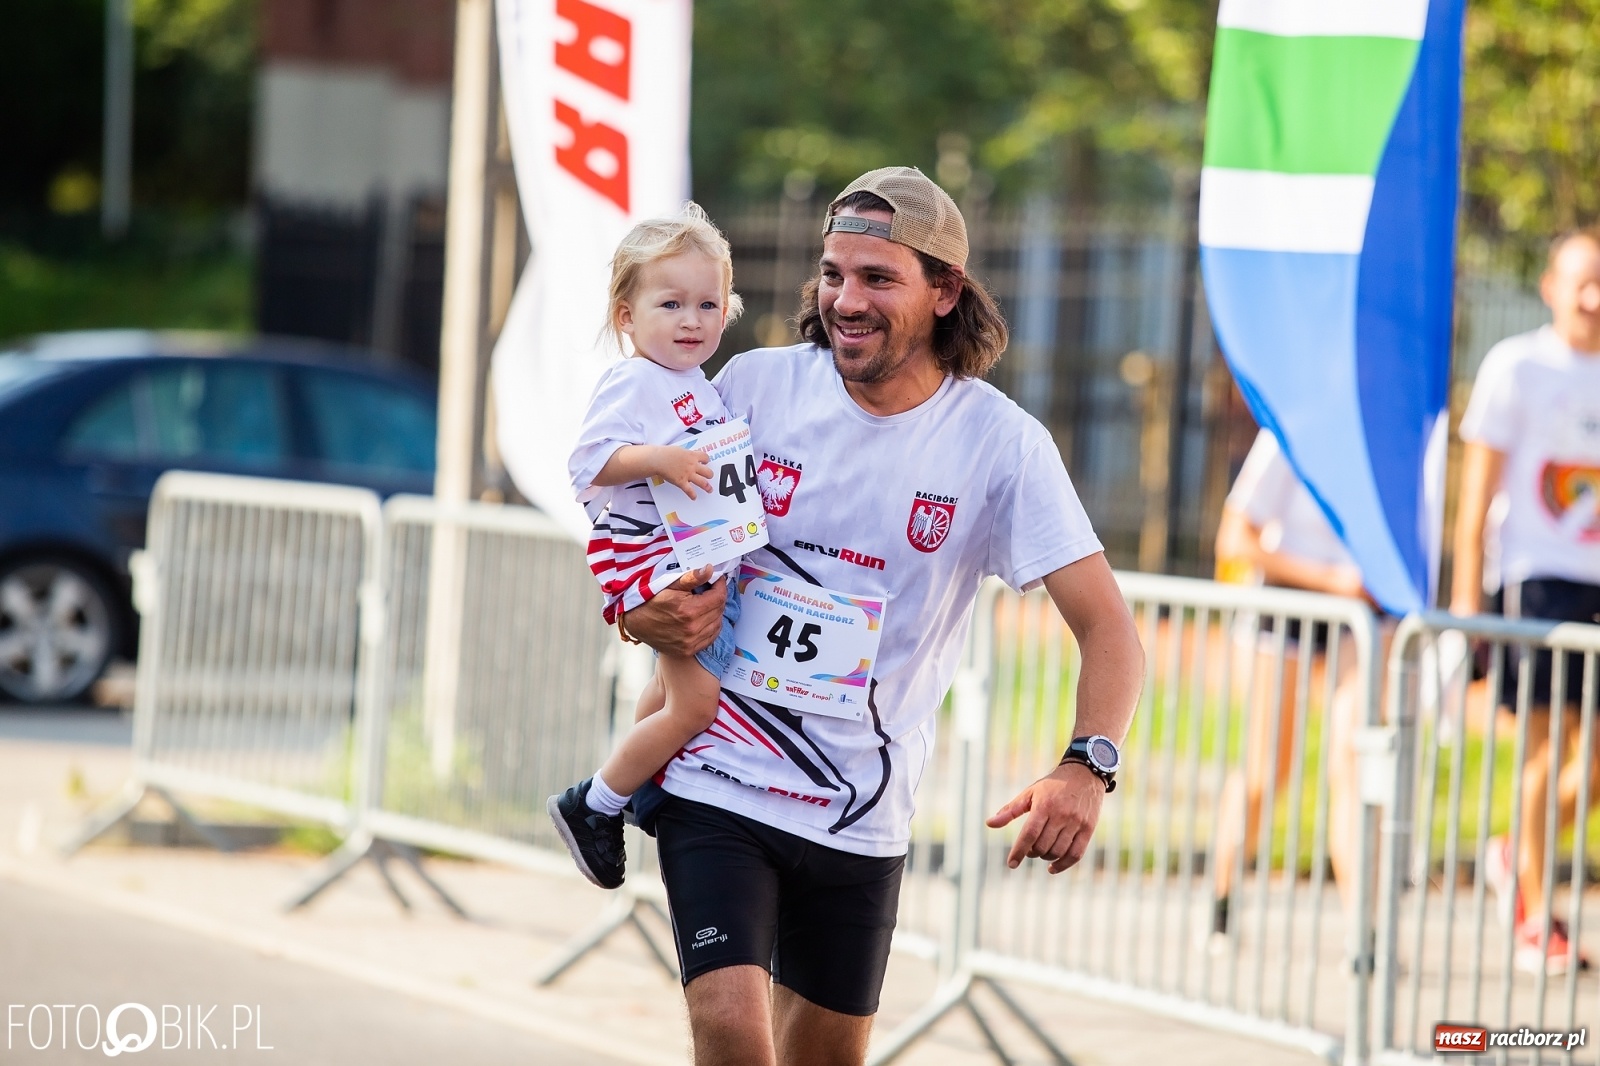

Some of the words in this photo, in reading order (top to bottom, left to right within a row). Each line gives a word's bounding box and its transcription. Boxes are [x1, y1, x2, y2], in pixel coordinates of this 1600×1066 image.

[671, 391, 691, 404] POLSKA
[719, 429, 750, 446] RAFAK
[763, 452, 802, 470] POLSKA
[719, 454, 760, 504] 44
[754, 590, 804, 613] PÓŁMARATON
[806, 607, 855, 625] RACIBÓRZ
[773, 585, 792, 598] MINI
[793, 591, 834, 611] RAFAKO
[766, 614, 822, 663] 45
